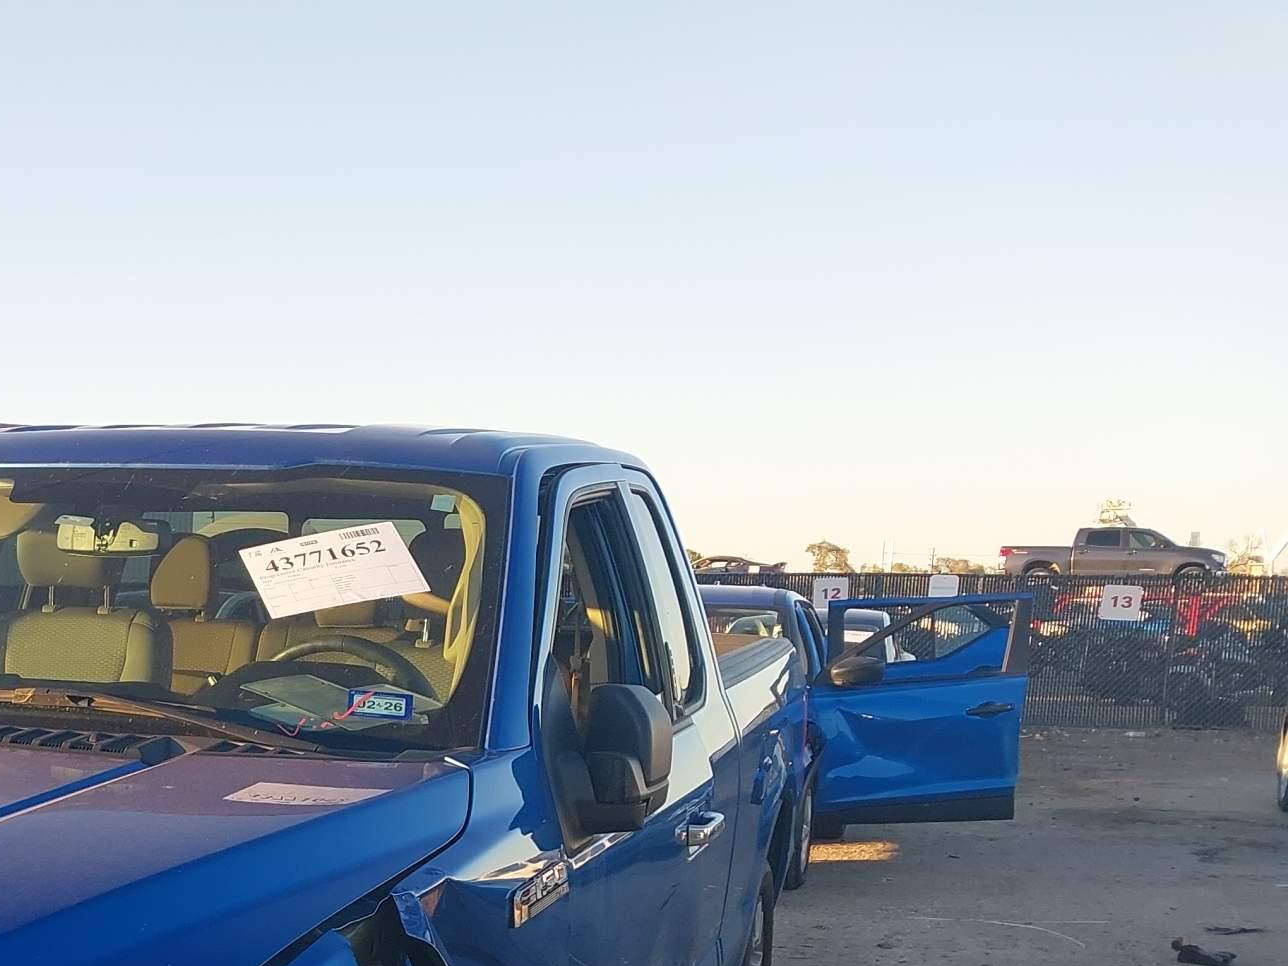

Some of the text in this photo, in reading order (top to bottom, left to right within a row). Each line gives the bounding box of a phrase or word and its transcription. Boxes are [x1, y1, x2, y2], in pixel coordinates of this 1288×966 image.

[265, 539, 387, 573] 43771652
[822, 587, 841, 600] 12
[1111, 595, 1133, 609] 13
